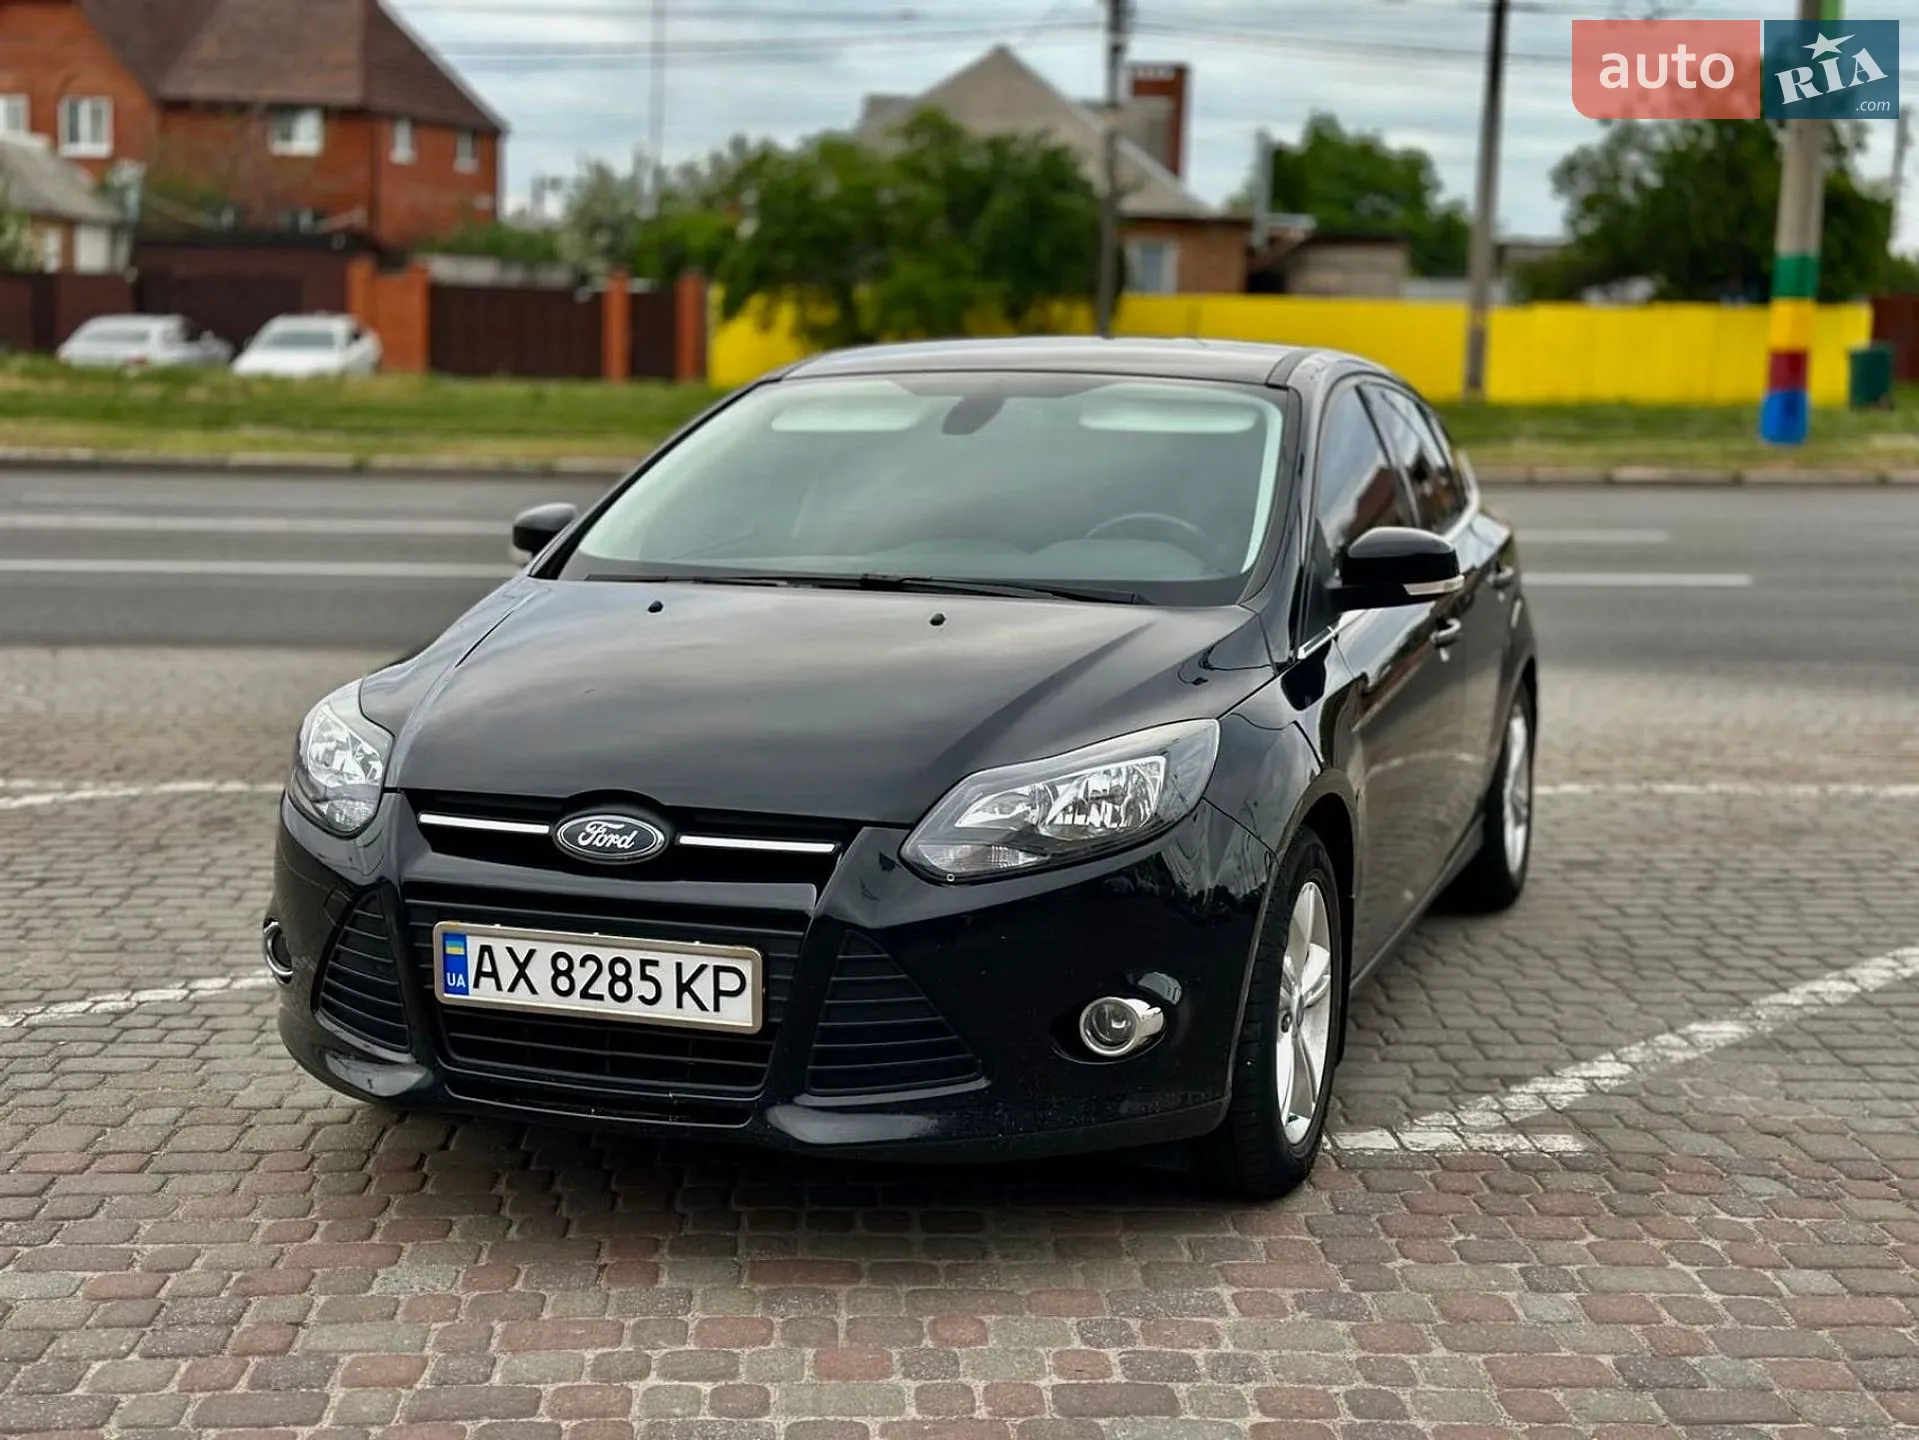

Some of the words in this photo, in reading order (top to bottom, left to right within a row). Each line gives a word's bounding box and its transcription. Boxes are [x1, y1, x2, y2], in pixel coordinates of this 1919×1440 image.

[578, 821, 638, 849] Ford
[446, 972, 467, 989] UA
[473, 944, 538, 995] AX
[550, 951, 664, 1006] 8285
[675, 961, 747, 1012] KP
